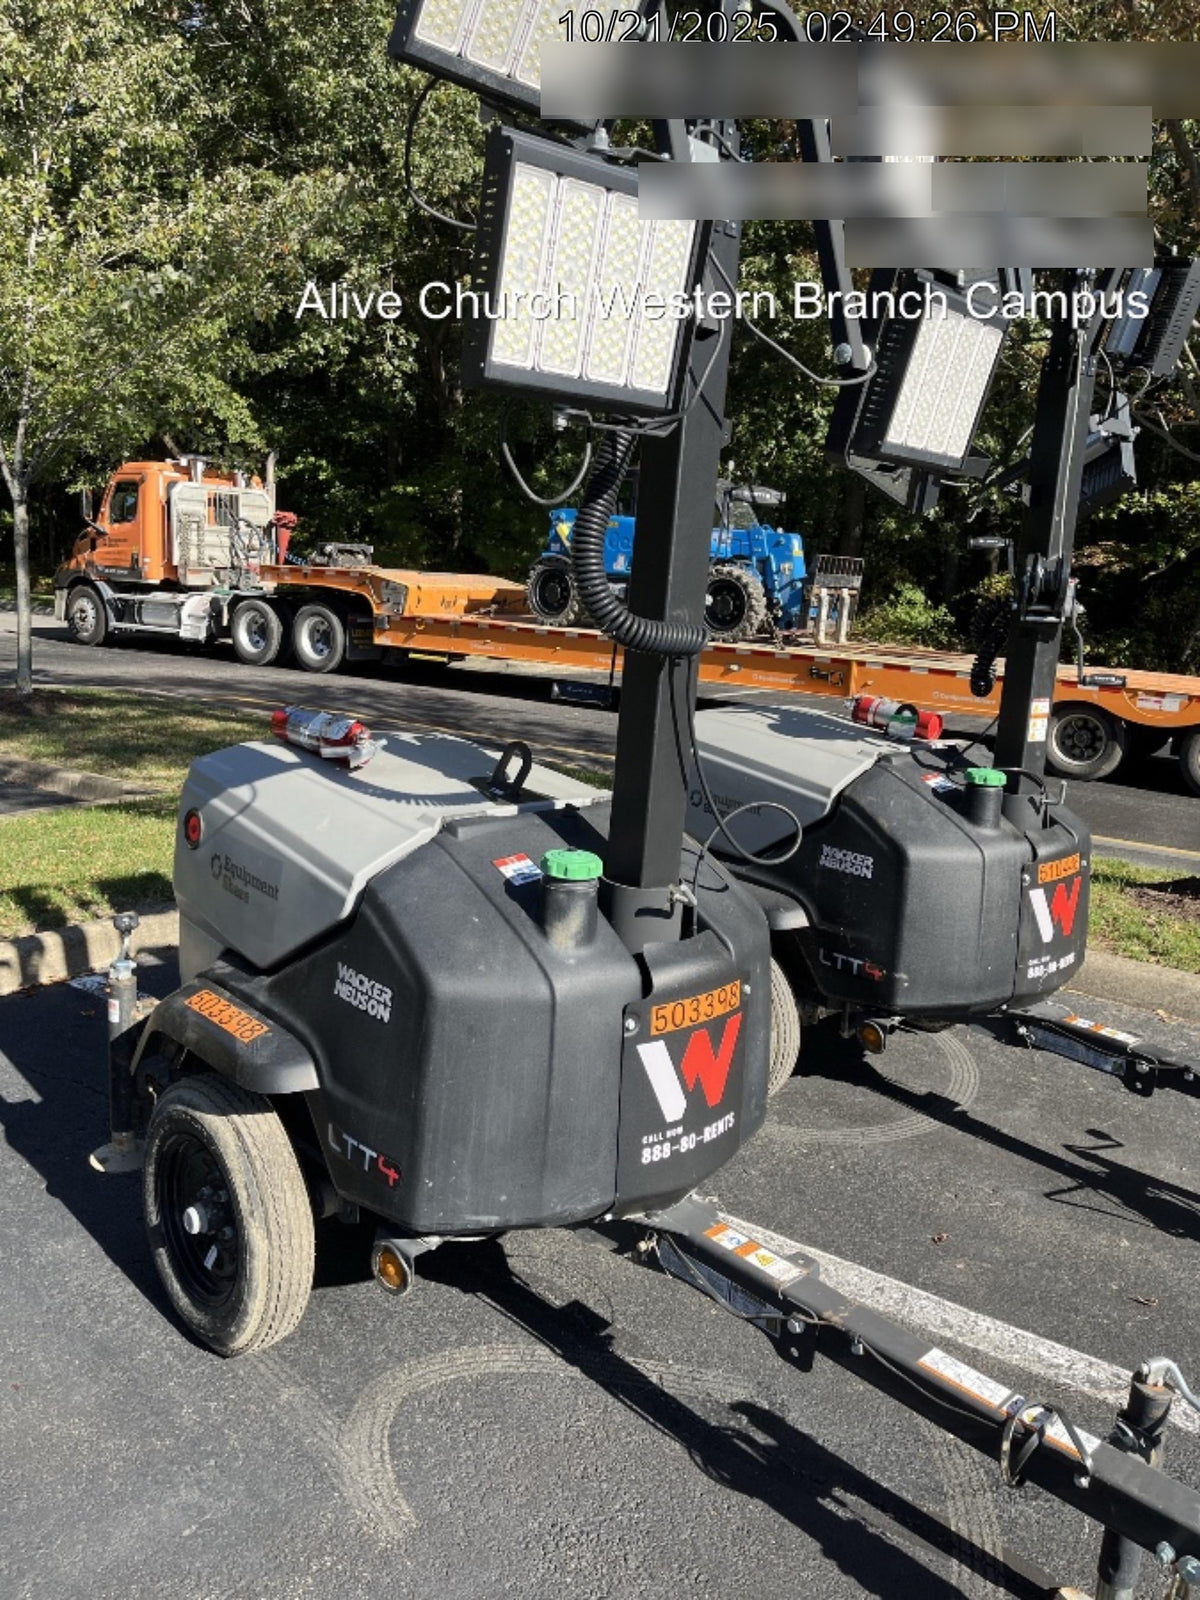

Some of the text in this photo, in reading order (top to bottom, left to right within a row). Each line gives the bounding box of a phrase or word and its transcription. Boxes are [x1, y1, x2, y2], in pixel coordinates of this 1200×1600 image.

[224, 853, 279, 902] Equipment
[337, 960, 393, 1006] WACKER
[819, 948, 882, 981] LTT4
[188, 990, 266, 1041] 503398
[333, 979, 392, 1024] NEUSON
[654, 982, 740, 1032] 503398
[327, 1122, 400, 1188] LTT4
[641, 1110, 735, 1165] 888-80-RENTS
